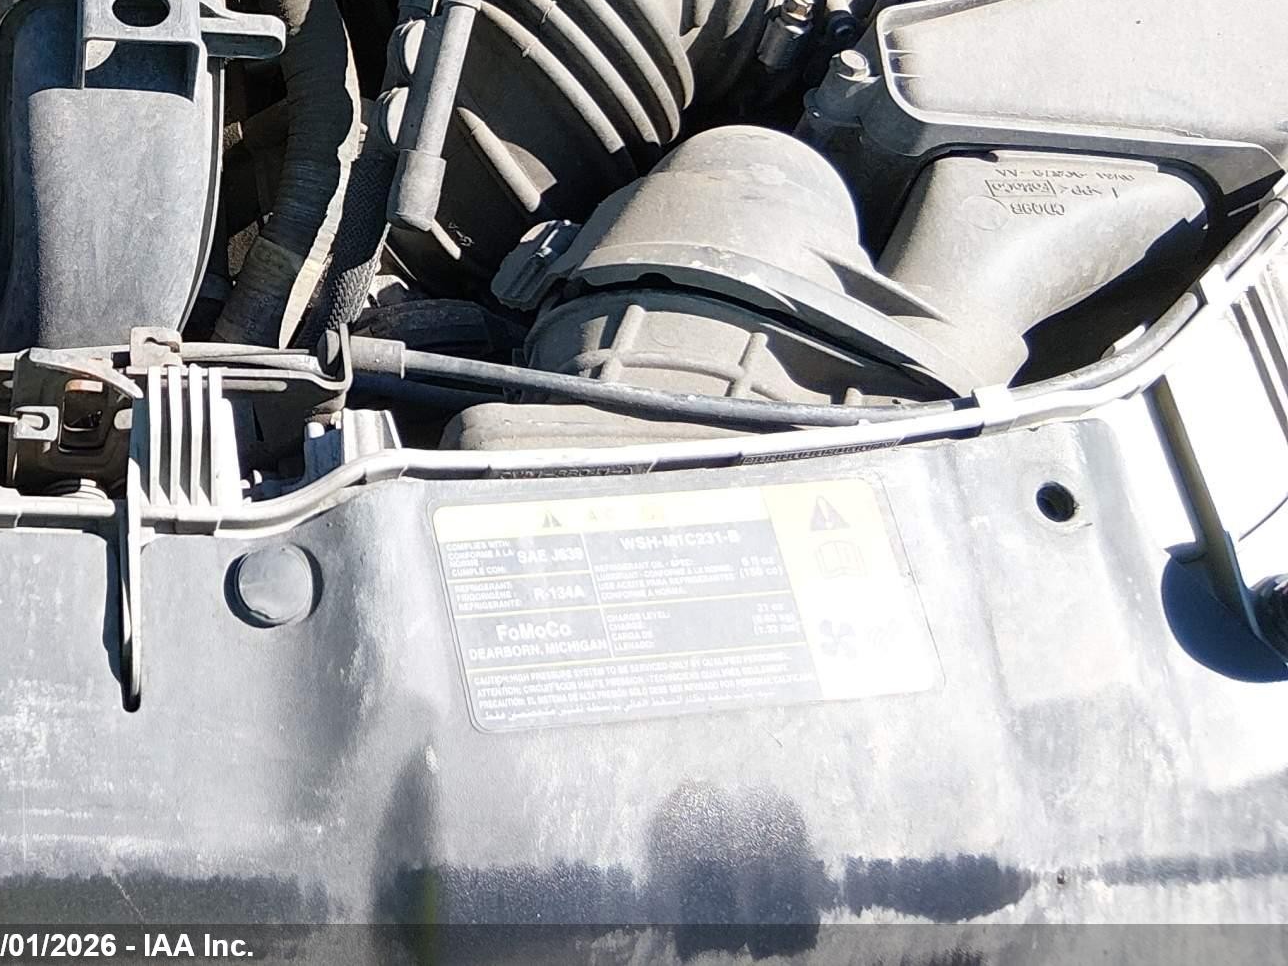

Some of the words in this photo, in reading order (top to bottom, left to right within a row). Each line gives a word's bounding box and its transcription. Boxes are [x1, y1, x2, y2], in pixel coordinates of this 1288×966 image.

[516, 548, 548, 564] SAE
[533, 584, 585, 601] R-134A
[495, 619, 572, 641] FoMoCo
[467, 643, 544, 660] DEARBORN,
[544, 638, 608, 654] MICHIGAN
